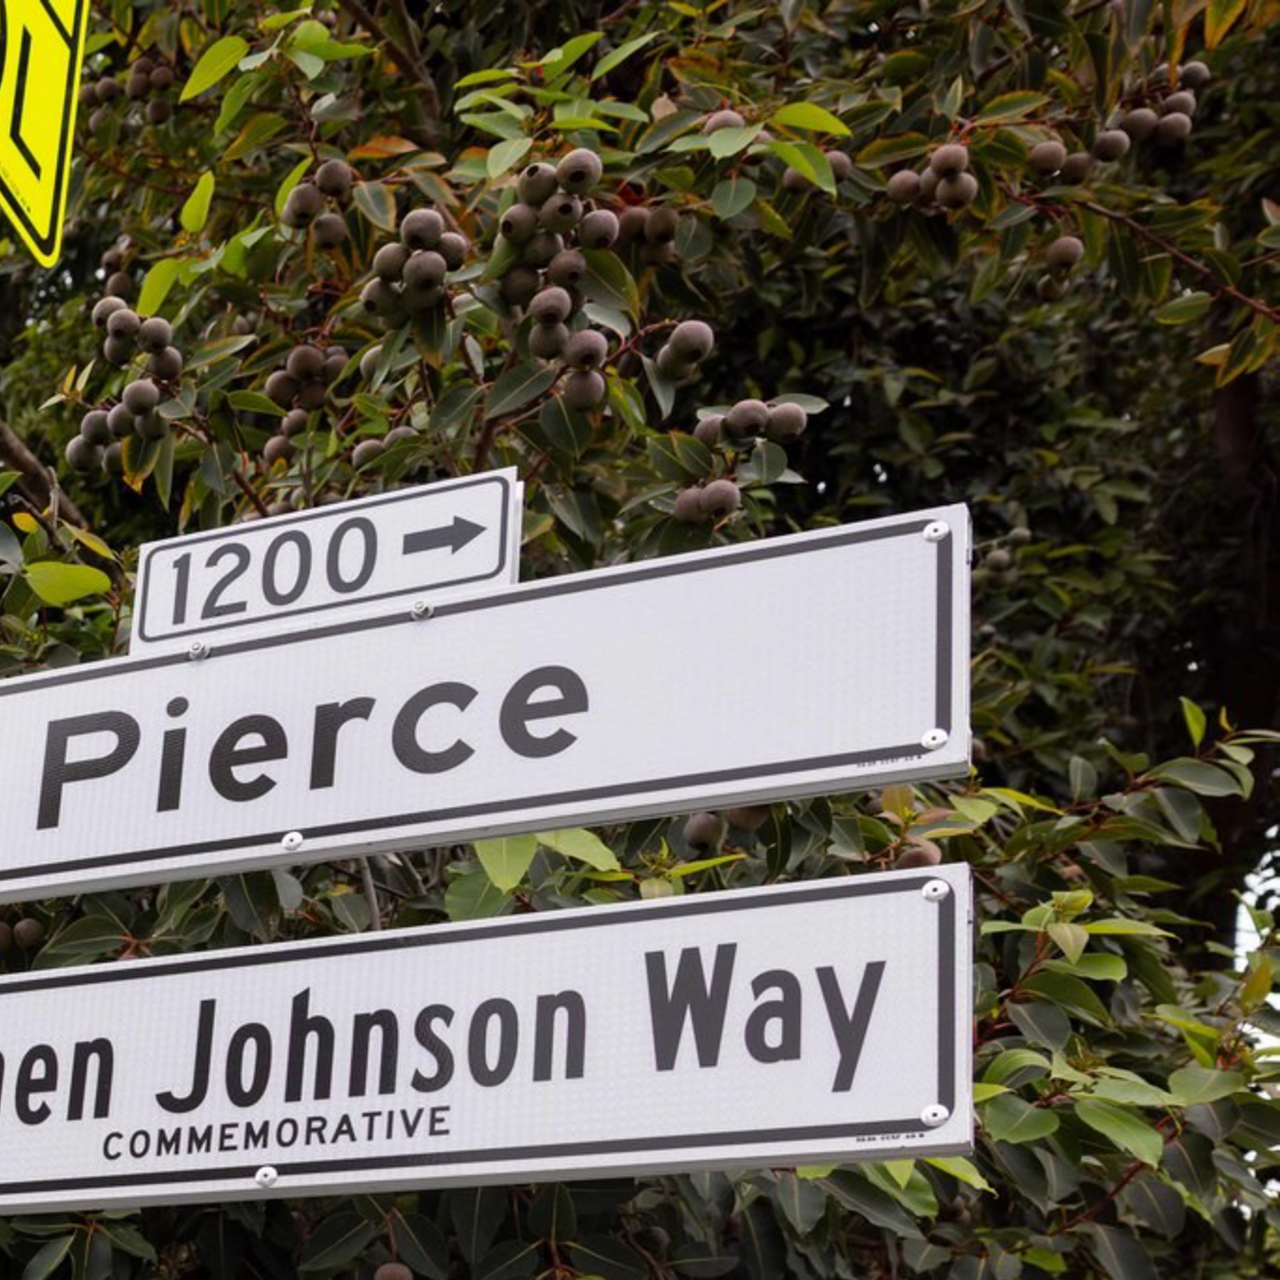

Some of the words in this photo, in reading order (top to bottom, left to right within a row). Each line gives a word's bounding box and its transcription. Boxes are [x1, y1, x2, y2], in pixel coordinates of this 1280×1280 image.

[173, 517, 377, 624] 1200
[37, 666, 588, 830] Pierce
[156, 988, 585, 1113] Johnson
[645, 943, 886, 1092] Way
[103, 1106, 450, 1160] COMMEMORATIVE
